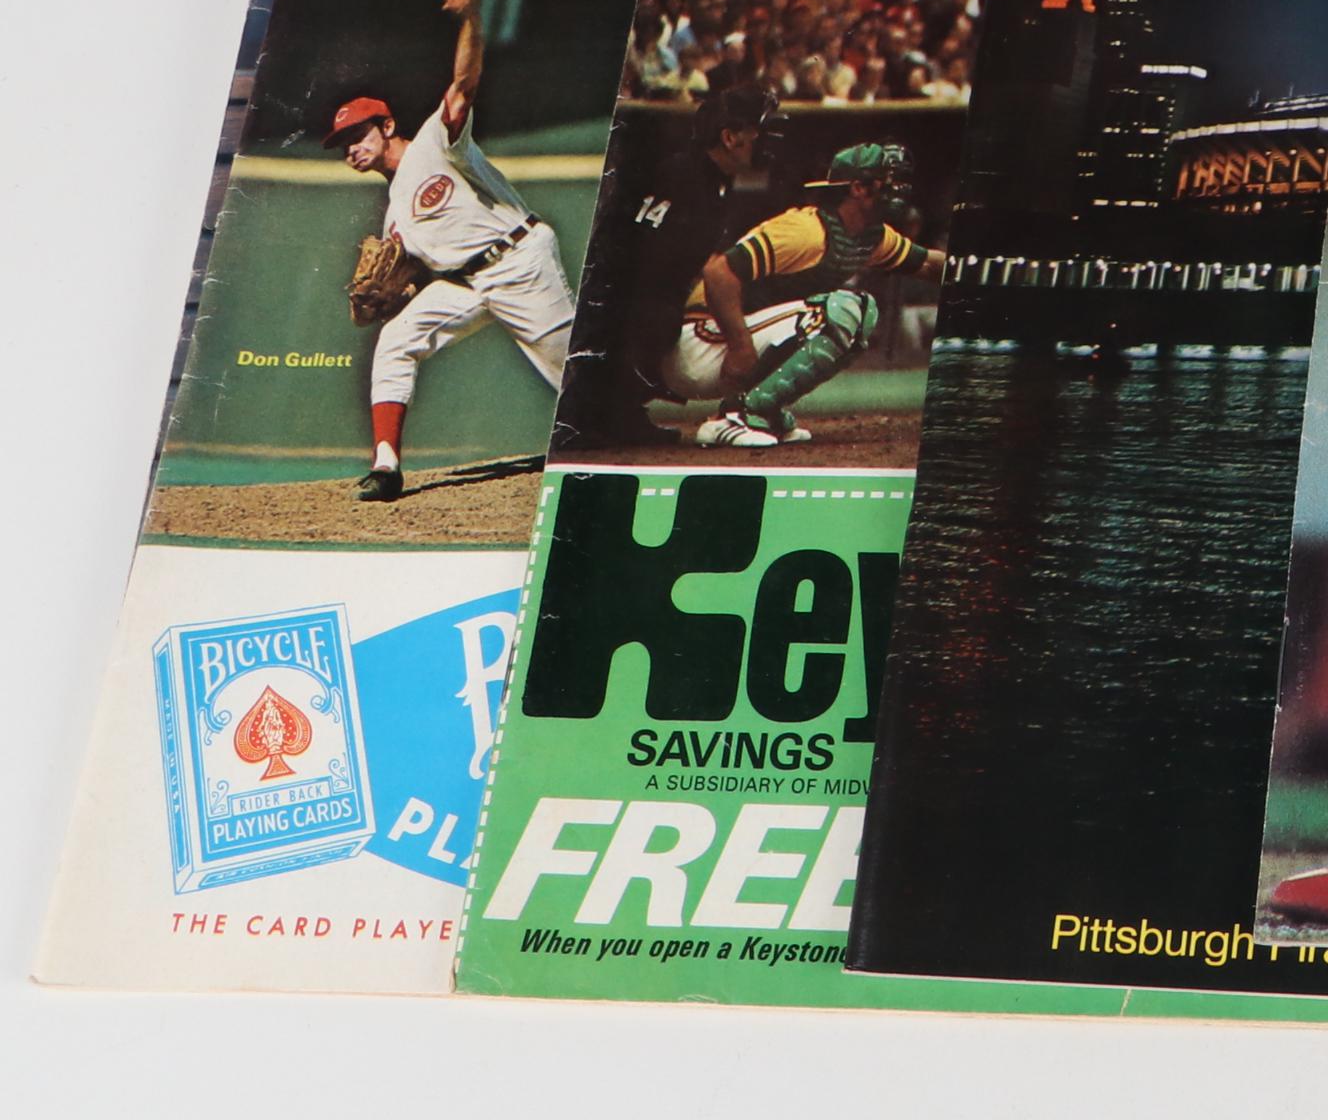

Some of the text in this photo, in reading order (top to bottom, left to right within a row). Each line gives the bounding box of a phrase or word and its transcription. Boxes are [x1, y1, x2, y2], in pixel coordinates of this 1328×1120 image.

[634, 195, 670, 229] 14
[236, 350, 353, 368] Don Gullett
[199, 625, 334, 704] BICYCLE
[626, 728, 835, 772] SAVINGS
[239, 785, 324, 813] RIDER BACK
[645, 775, 818, 795] A SUBSIDIARY OF
[212, 799, 353, 845] PLAYING CARDS
[172, 912, 453, 941] THE CARD PLAYE
[1051, 914, 1254, 967] Pittsburgh
[520, 929, 600, 956] When
[596, 936, 644, 961] you
[649, 939, 710, 962] open
[716, 943, 731, 960] a
